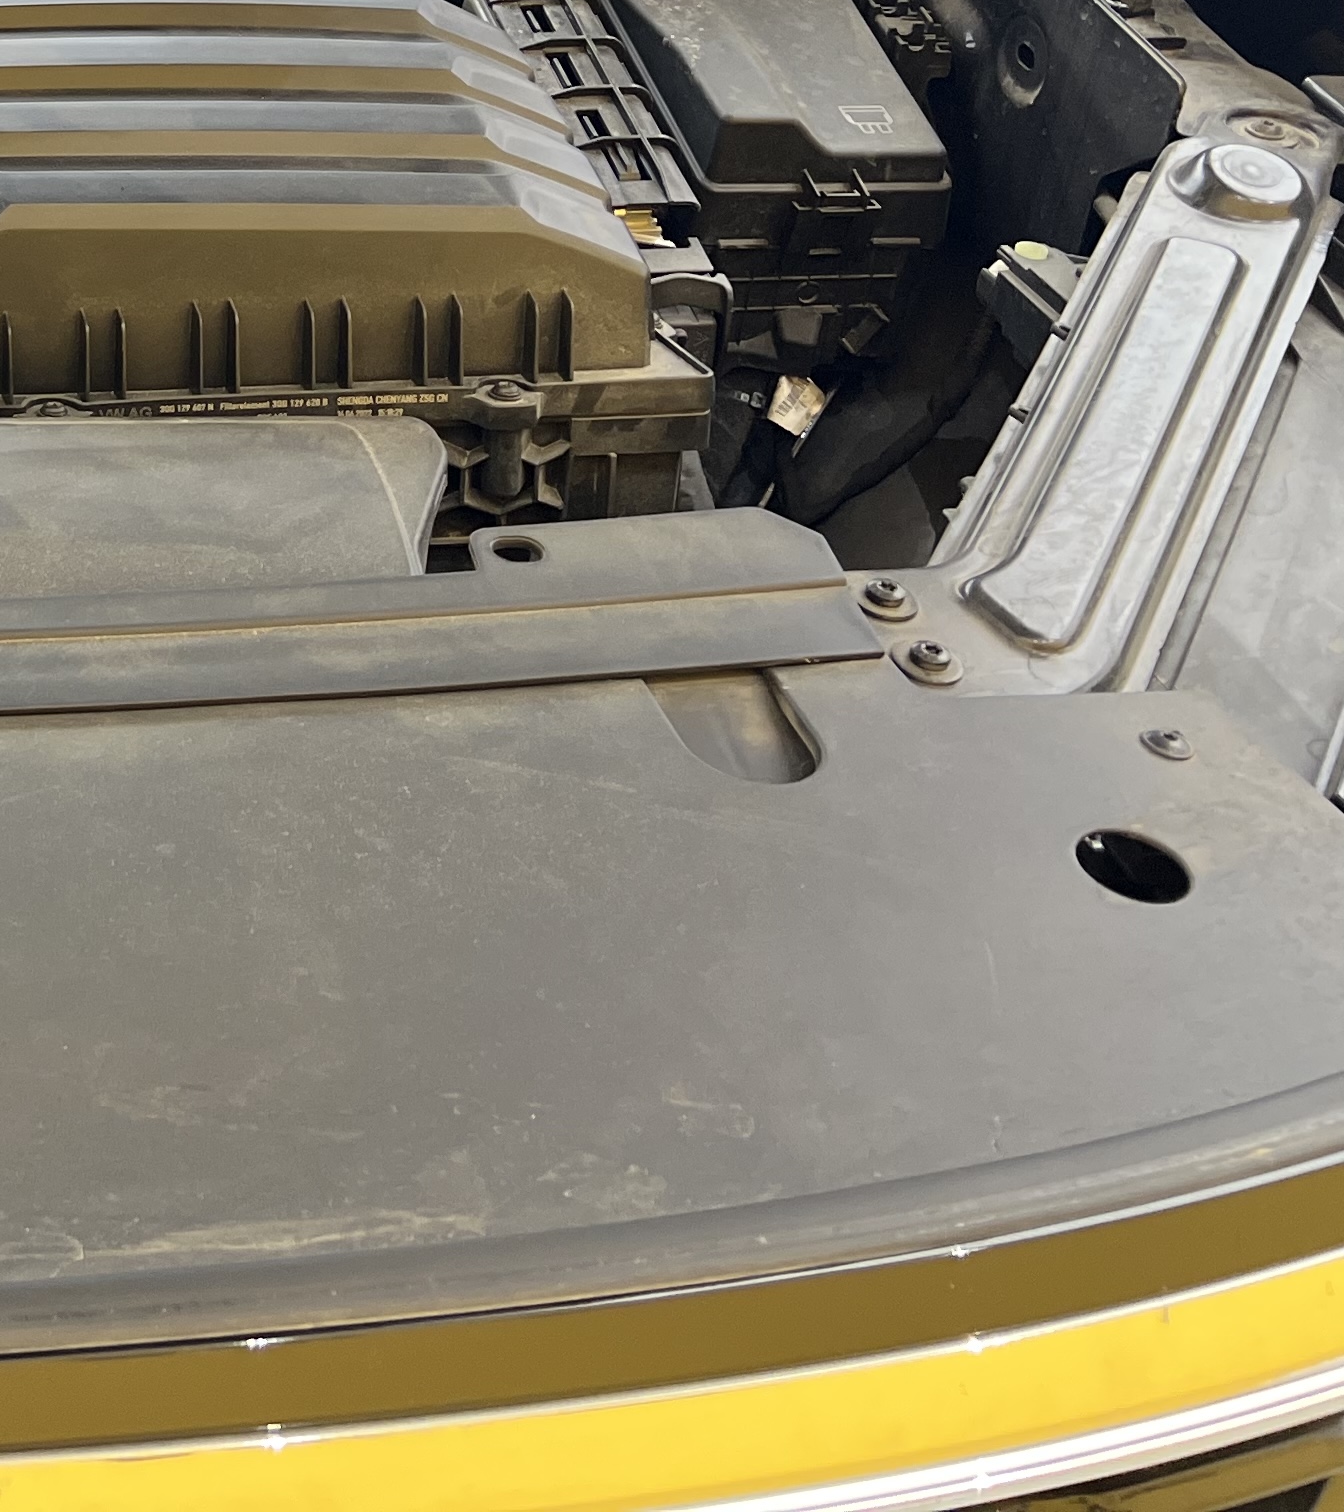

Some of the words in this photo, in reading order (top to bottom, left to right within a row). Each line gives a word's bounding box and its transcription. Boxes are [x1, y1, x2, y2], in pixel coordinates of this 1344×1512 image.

[128, 405, 153, 418] AG
[290, 398, 305, 408] 129
[337, 395, 374, 406] SHENGDA
[375, 394, 418, 405] CHENYANG
